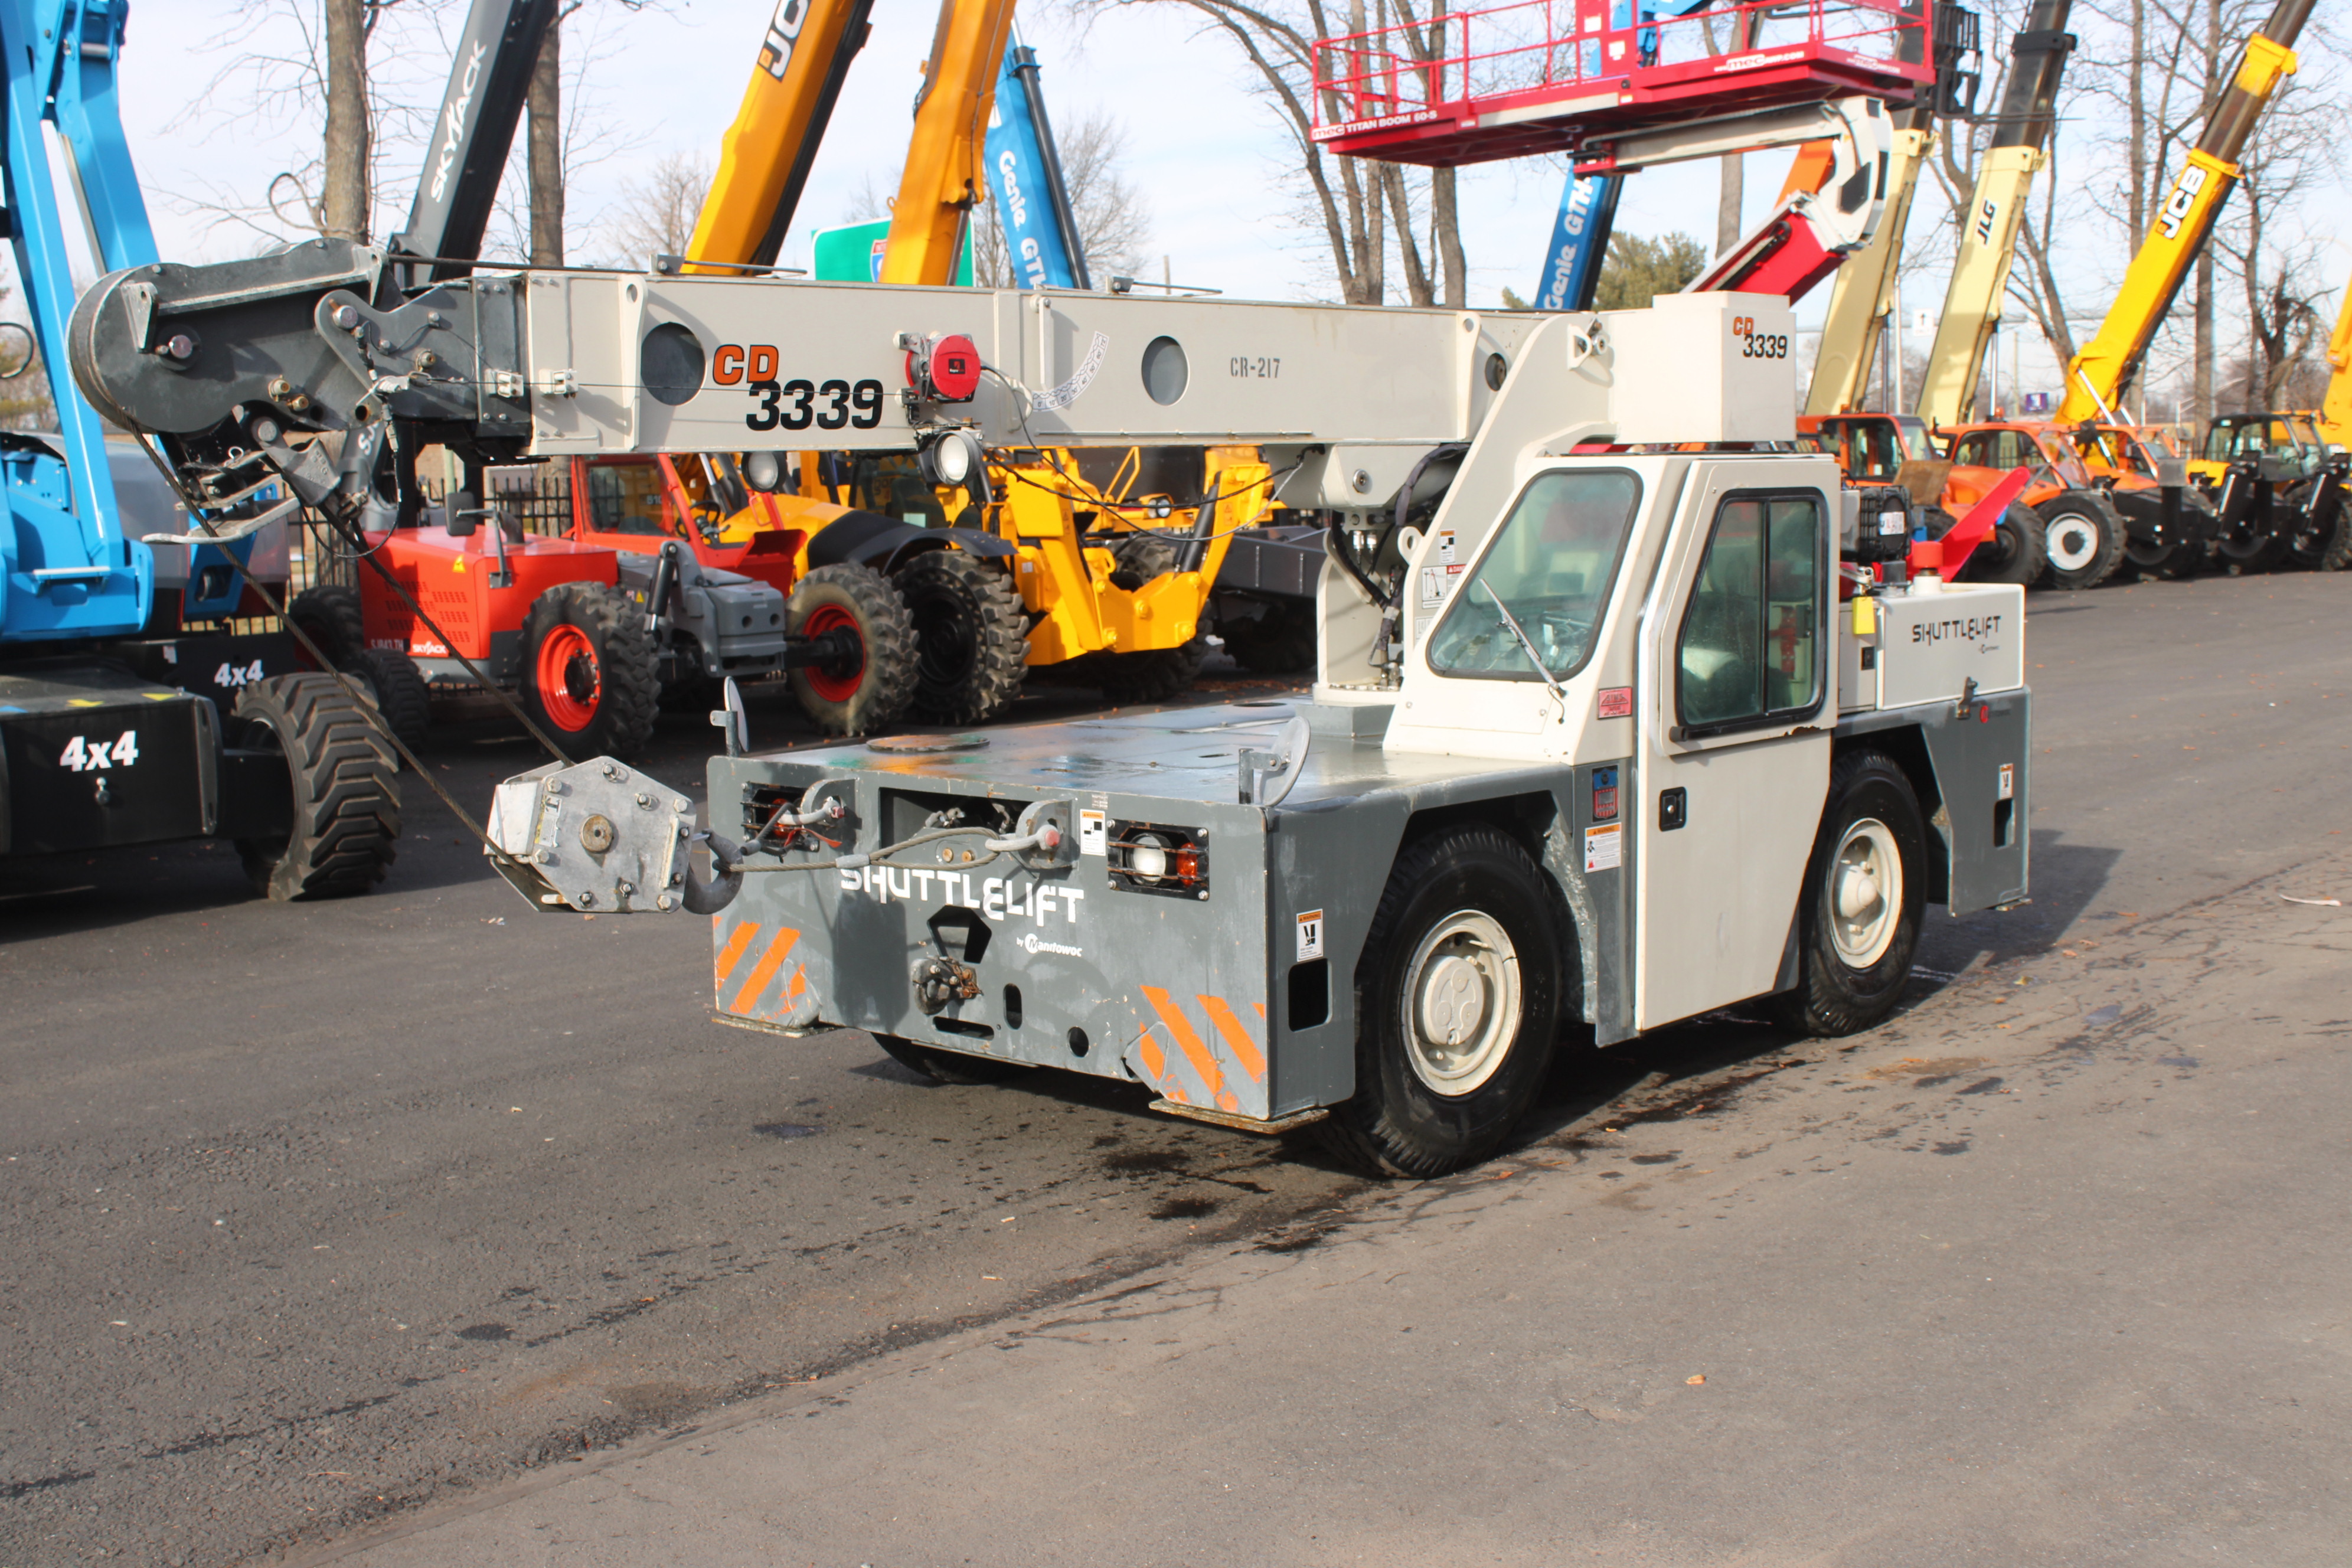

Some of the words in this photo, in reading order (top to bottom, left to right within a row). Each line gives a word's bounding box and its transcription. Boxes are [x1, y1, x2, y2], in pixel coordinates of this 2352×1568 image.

[430, 39, 487, 202] SKYJACK
[1346, 120, 1377, 133] TITAN
[1378, 115, 1411, 128] BOOM
[999, 151, 1026, 229] Genie
[2161, 165, 2207, 239] JCB
[1978, 198, 1996, 245] JLG
[1544, 243, 1578, 310] Genie
[1733, 316, 1754, 335] CD
[713, 344, 779, 385] CD
[1743, 334, 1788, 359] 3339
[1230, 357, 1280, 378] CR-217
[746, 379, 883, 430] 3339
[413, 641, 447, 655] SKYJACK
[1912, 615, 2001, 646] SHUTTLELIFT
[214, 659, 263, 687] 4x4
[60, 730, 139, 772] 4x4
[841, 865, 1084, 926] SHUTTLELIFT
[1016, 937, 1024, 947] by
[1025, 933, 1083, 957] Manitowoc
